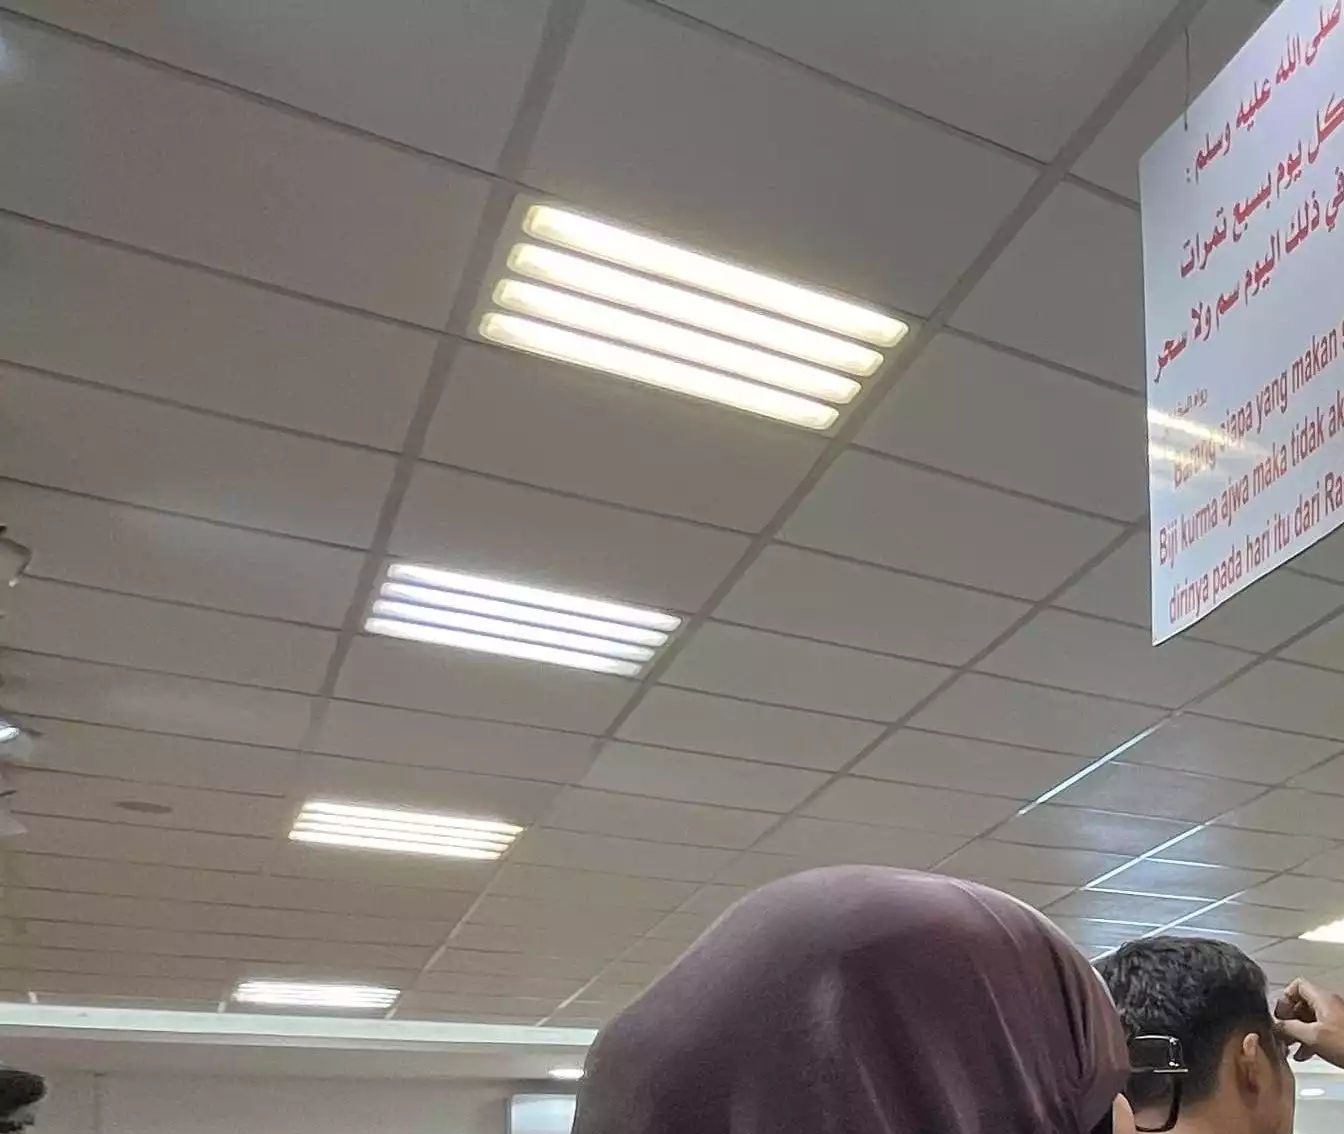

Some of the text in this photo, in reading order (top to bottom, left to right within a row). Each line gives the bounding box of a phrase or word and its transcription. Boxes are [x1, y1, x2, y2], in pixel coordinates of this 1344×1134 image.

[1277, 32, 1301, 83] الله
[1235, 78, 1272, 131] عليه
[1276, 138, 1302, 199] يوم
[1180, 206, 1227, 278] تمرات
[1285, 189, 1321, 254] ذلك
[1243, 229, 1282, 306] اليوم
[1190, 300, 1212, 342] ولا
[1215, 281, 1240, 332] سم
[1153, 330, 1188, 384] سحر
[1255, 370, 1289, 434] yang
[1291, 327, 1339, 394] makan
[1158, 518, 1179, 569] Biji
[1180, 495, 1218, 549] kurma
[1220, 473, 1250, 527] ajwa
[1252, 442, 1288, 496] maka
[1290, 406, 1326, 468] tidak
[1168, 571, 1210, 624] dirinya
[1212, 544, 1243, 605] pada
[1245, 520, 1271, 574] hari
[1273, 512, 1291, 554] itu
[1294, 480, 1322, 538] dari
